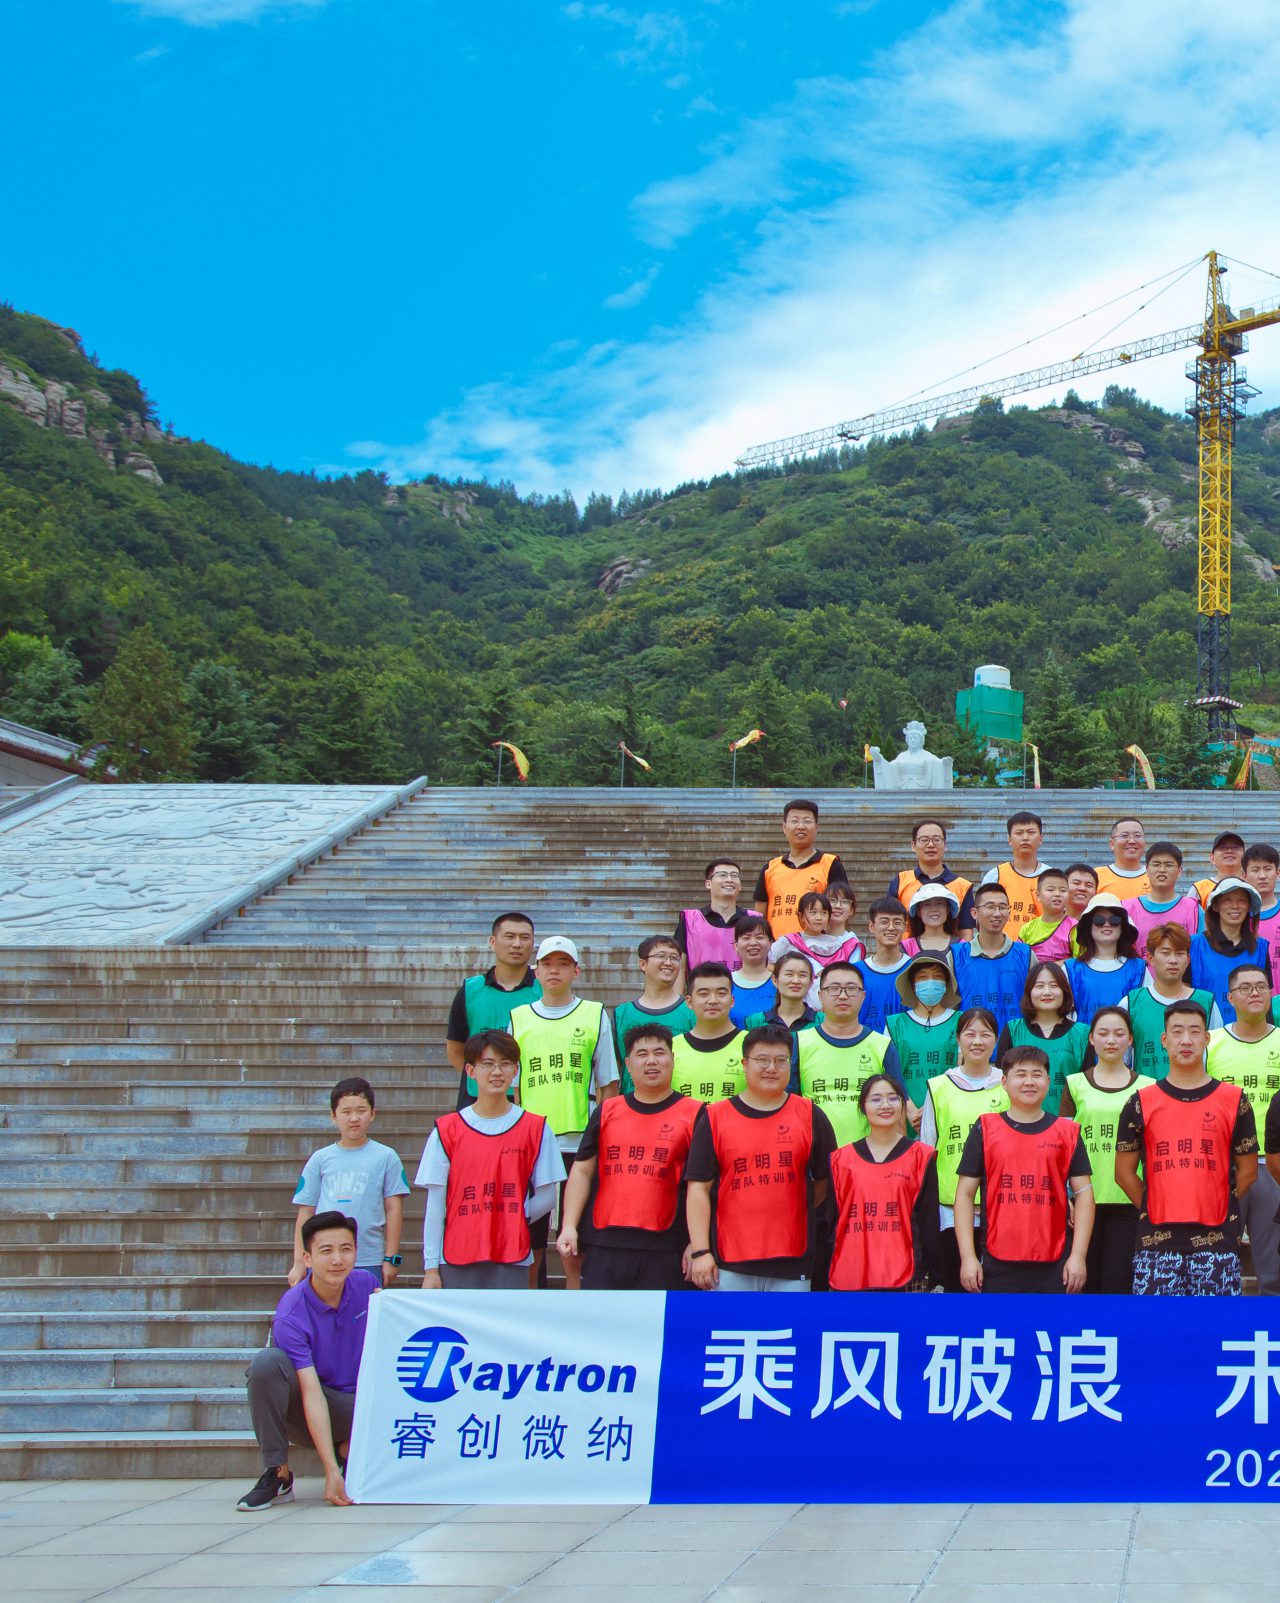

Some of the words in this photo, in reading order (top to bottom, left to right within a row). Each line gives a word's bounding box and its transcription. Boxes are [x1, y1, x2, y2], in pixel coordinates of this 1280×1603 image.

[774, 893, 797, 906] 启明
[1009, 901, 1037, 914] 明星
[529, 1052, 582, 1072] 启明星
[909, 1050, 957, 1066] 启明星
[1142, 1056, 1170, 1068] 团队特
[527, 1071, 584, 1088] 团队特训营
[904, 1068, 940, 1080] 团队特
[680, 1081, 736, 1096] 启明星
[1084, 1123, 1114, 1139] 启明
[606, 1145, 669, 1163] 启明星
[1156, 1139, 1214, 1157] 启明星
[734, 1150, 794, 1175] 启明星
[1153, 1158, 1217, 1172] 团队特训营
[604, 1164, 669, 1179] 团队特训营
[730, 1171, 797, 1191] 团队特训营
[1000, 1174, 1054, 1191] 启明星
[463, 1182, 517, 1200] 启明星
[458, 1201, 520, 1217] 团队特训营
[848, 1201, 899, 1218] 启明星
[420, 1341, 637, 1400] Raytron
[700, 1328, 1123, 1423] 乘风破浪
[390, 1411, 634, 1462] 睿创微纳
